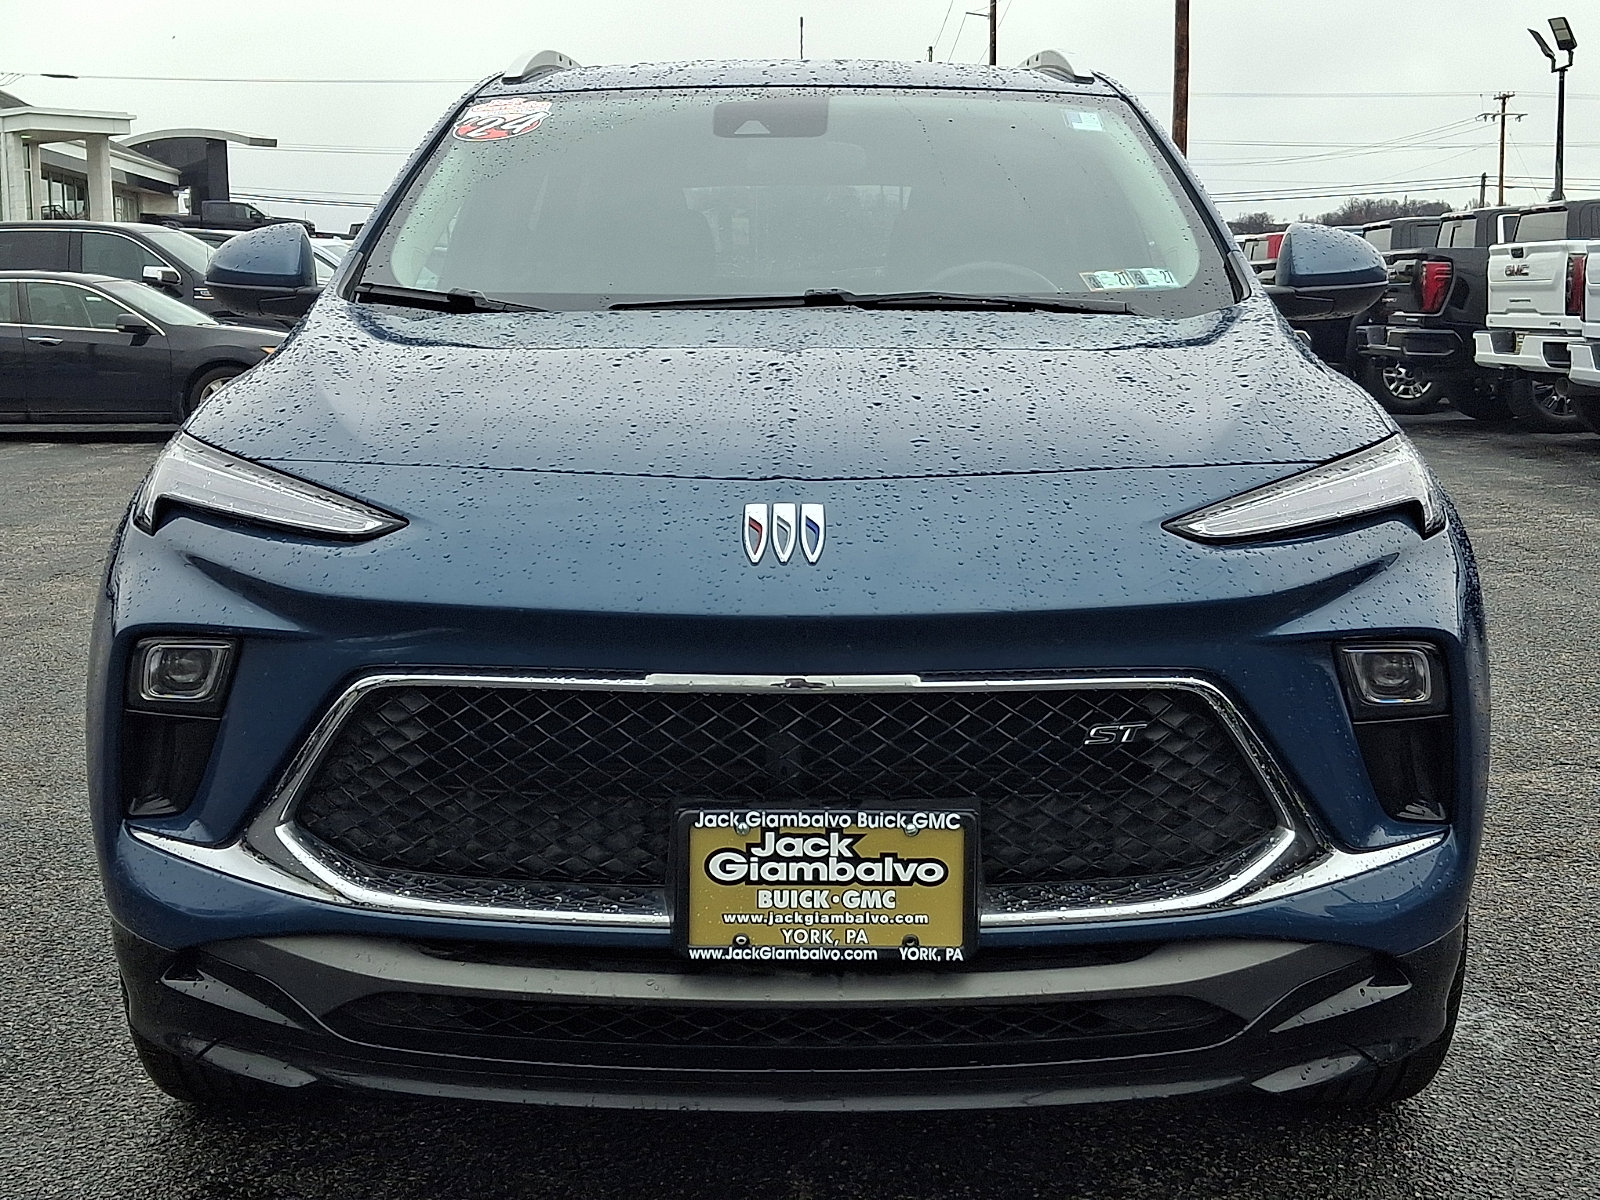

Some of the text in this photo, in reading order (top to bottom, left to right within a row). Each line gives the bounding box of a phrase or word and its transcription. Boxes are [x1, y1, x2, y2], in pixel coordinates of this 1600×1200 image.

[1504, 264, 1530, 277] GMC
[1084, 723, 1148, 745] ST
[694, 811, 961, 830] Jack Giambalvo Buick GMC
[750, 831, 854, 858] Jack
[708, 852, 945, 883] Giambalvo
[722, 911, 930, 926] www.jackgiambalvo.com
[780, 928, 869, 946] YORK, PA
[688, 945, 964, 962] www.JackGiambalvo.com YORK, PA
